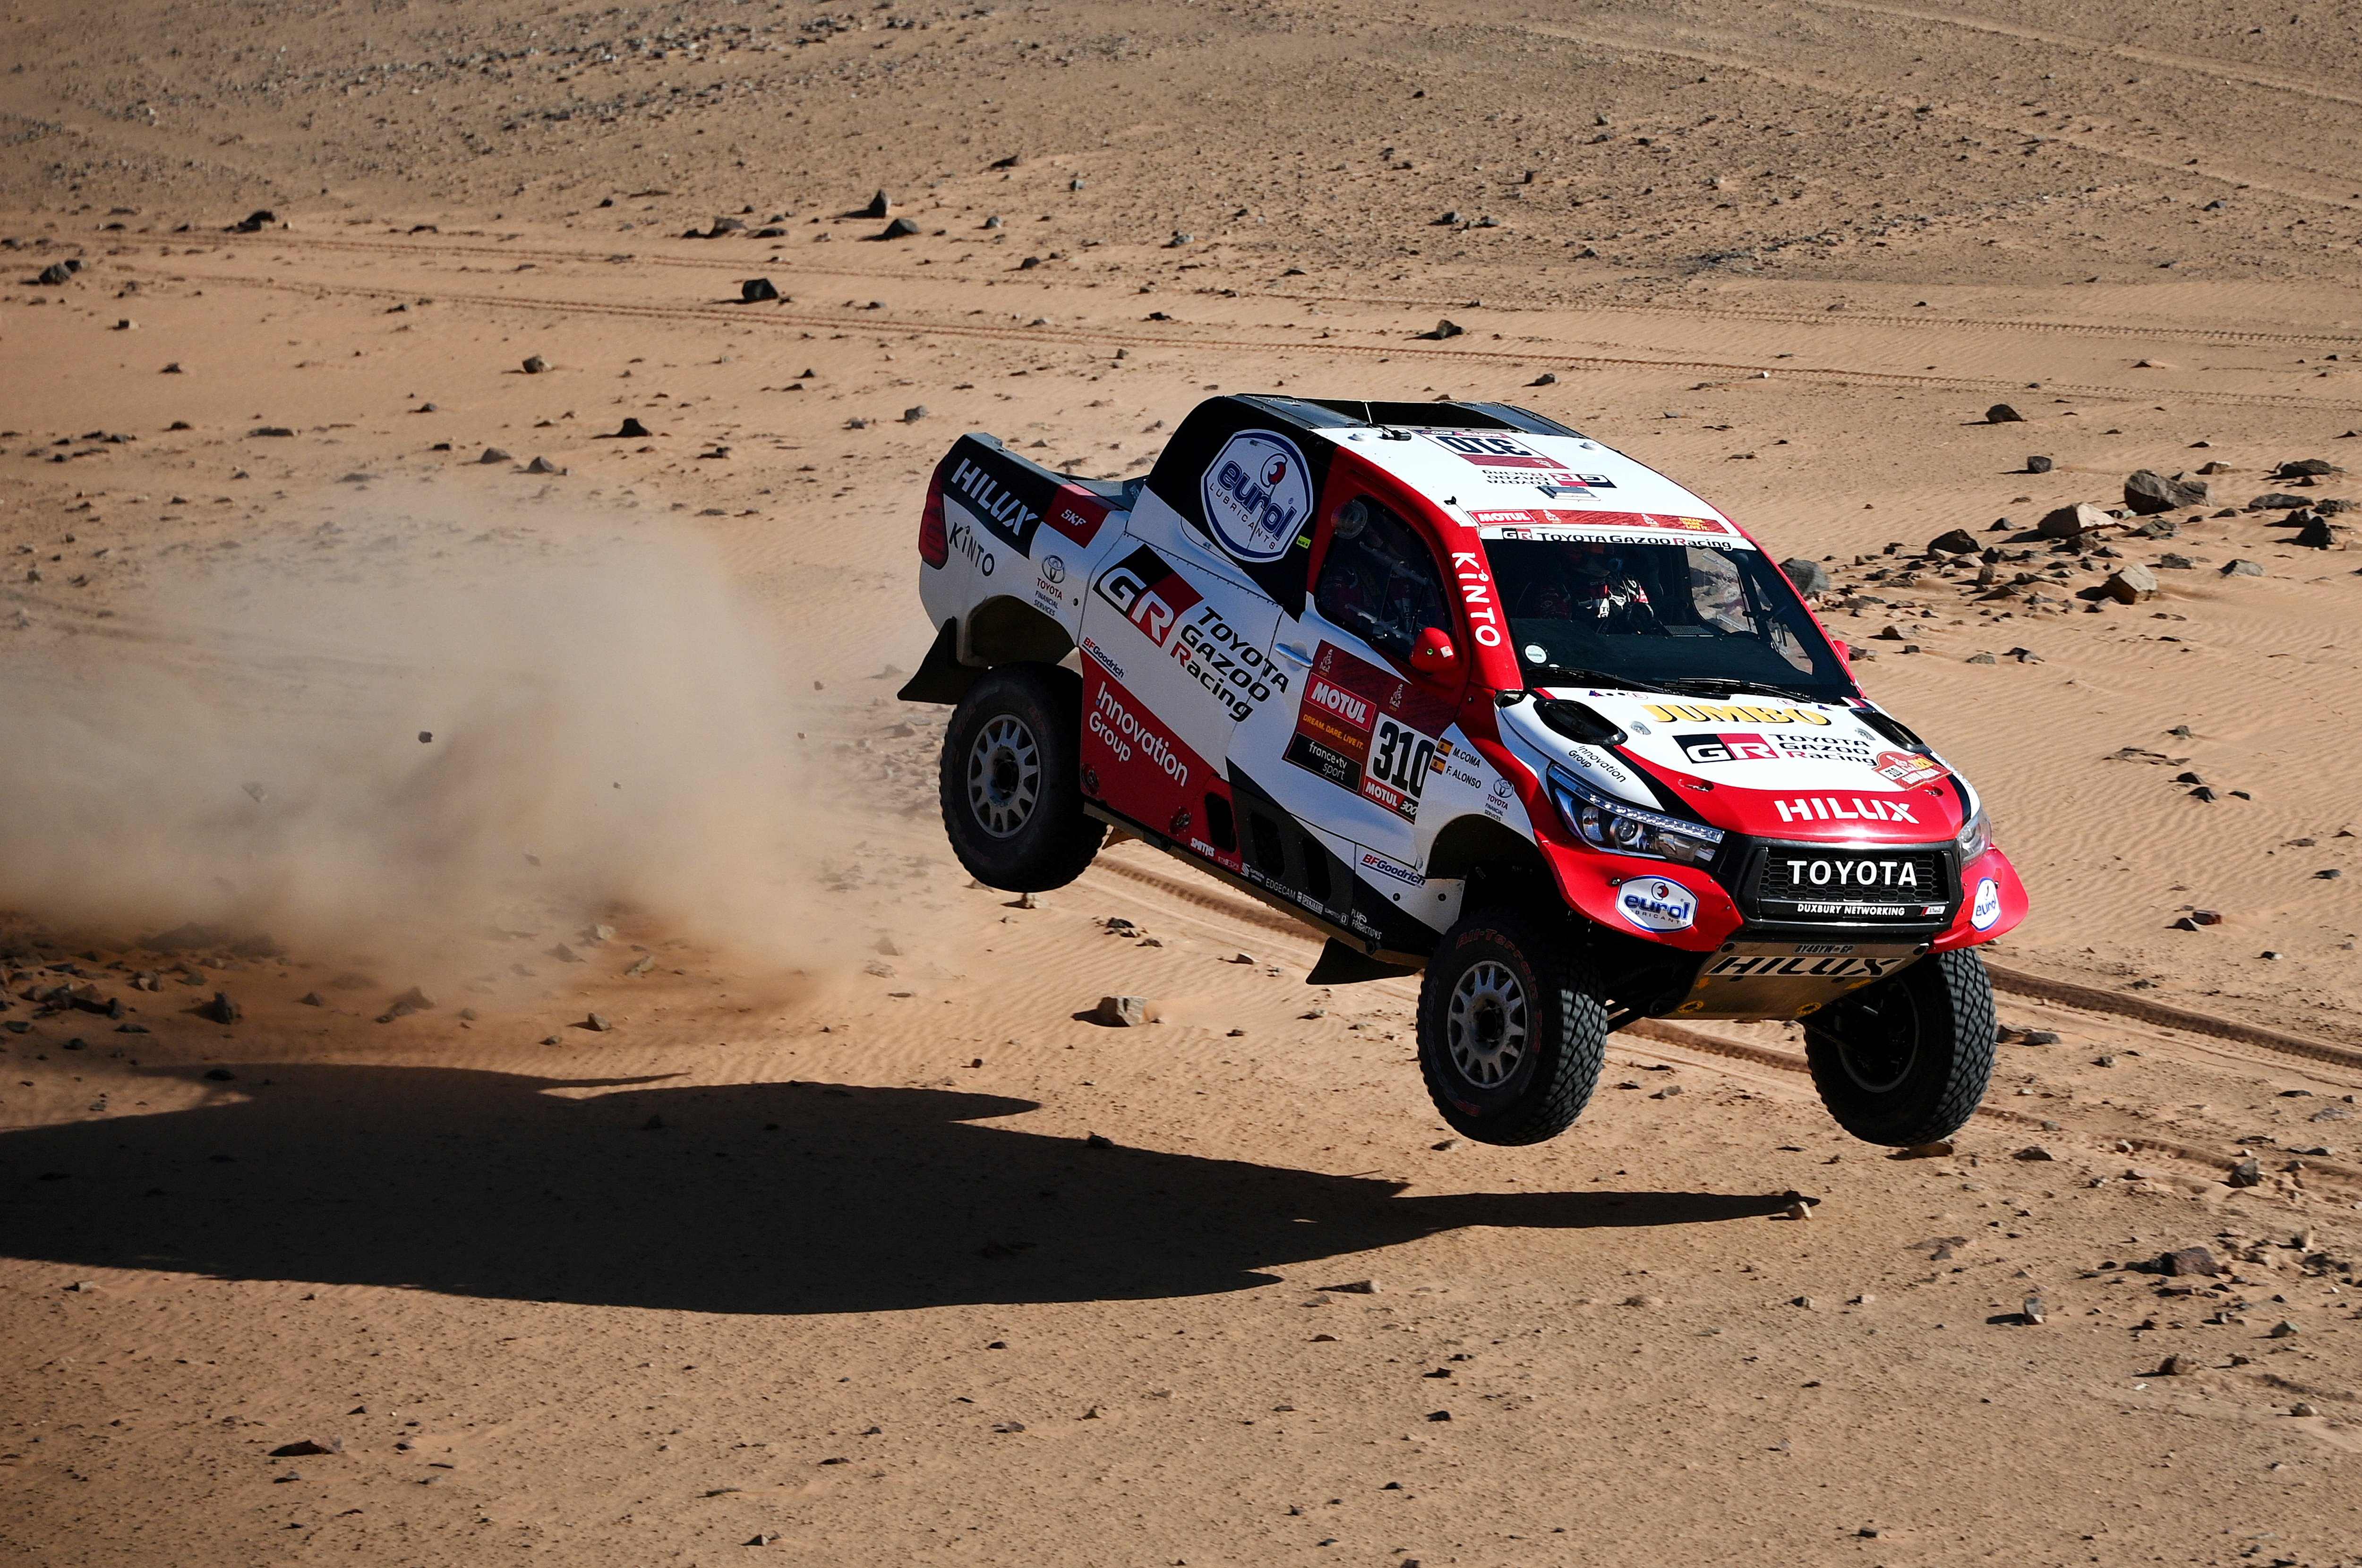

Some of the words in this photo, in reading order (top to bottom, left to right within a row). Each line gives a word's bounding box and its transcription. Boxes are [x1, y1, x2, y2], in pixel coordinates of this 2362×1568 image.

[1436, 436, 1532, 455] 310
[951, 458, 1038, 536] HILUX
[1217, 460, 1297, 541] eurol
[1061, 509, 1087, 528] SKF
[1209, 482, 1275, 550] LUBRICANTS
[1477, 512, 1531, 522] MOTUL
[1503, 529, 1532, 539] GR
[1537, 533, 1606, 543] TOYOTA
[1609, 535, 1670, 545] GAZOO
[1673, 538, 1731, 550] Racing
[1035, 590, 1059, 609] FINANCIAL
[1036, 577, 1063, 600] TOYOTA
[1034, 599, 1055, 616] SERVICES
[1099, 567, 1174, 643] GR
[1083, 637, 1124, 678] BFGoodrich
[1198, 606, 1290, 694] TOYOTA
[1181, 624, 1271, 702] GAZOO
[1170, 641, 1254, 722] Racing
[1311, 682, 1367, 724] MOTUL
[1641, 704, 1832, 725] JUMBO
[1089, 711, 1131, 762] Group
[1096, 681, 1188, 787] Innovation
[1303, 714, 1325, 730] DREAM.
[1326, 726, 1343, 739] DARE.
[1343, 734, 1357, 745] LIVE
[1355, 741, 1364, 750] IT.
[1769, 734, 1871, 747] TOYOTA
[1373, 721, 1436, 799] 310
[1452, 747, 1481, 768] M.COMA
[1568, 749, 1592, 768] Group
[1686, 742, 1778, 762] GR
[1779, 742, 1870, 755] GAZOO
[1786, 751, 1878, 766] Racing
[1323, 763, 1345, 780] sport
[1578, 745, 1626, 783] Innovation
[1446, 765, 1454, 776] F.
[1452, 767, 1481, 789] ALONSO
[1365, 782, 1398, 807] MOTUL
[1487, 794, 1508, 810] TOYOTA
[1484, 810, 1501, 822] SERVICES
[1485, 803, 1504, 816] FINANCIAL
[1774, 798, 1919, 824] HILUX
[1362, 853, 1426, 886] BFGoodrich
[1787, 861, 1917, 886] TOYOTA
[1266, 878, 1296, 900] EDGECAM
[1624, 895, 1690, 920] eurol
[1797, 903, 1842, 914] DUXBURY
[1844, 906, 1905, 916] NETWORKING
[1708, 957, 1901, 975] HILUX
